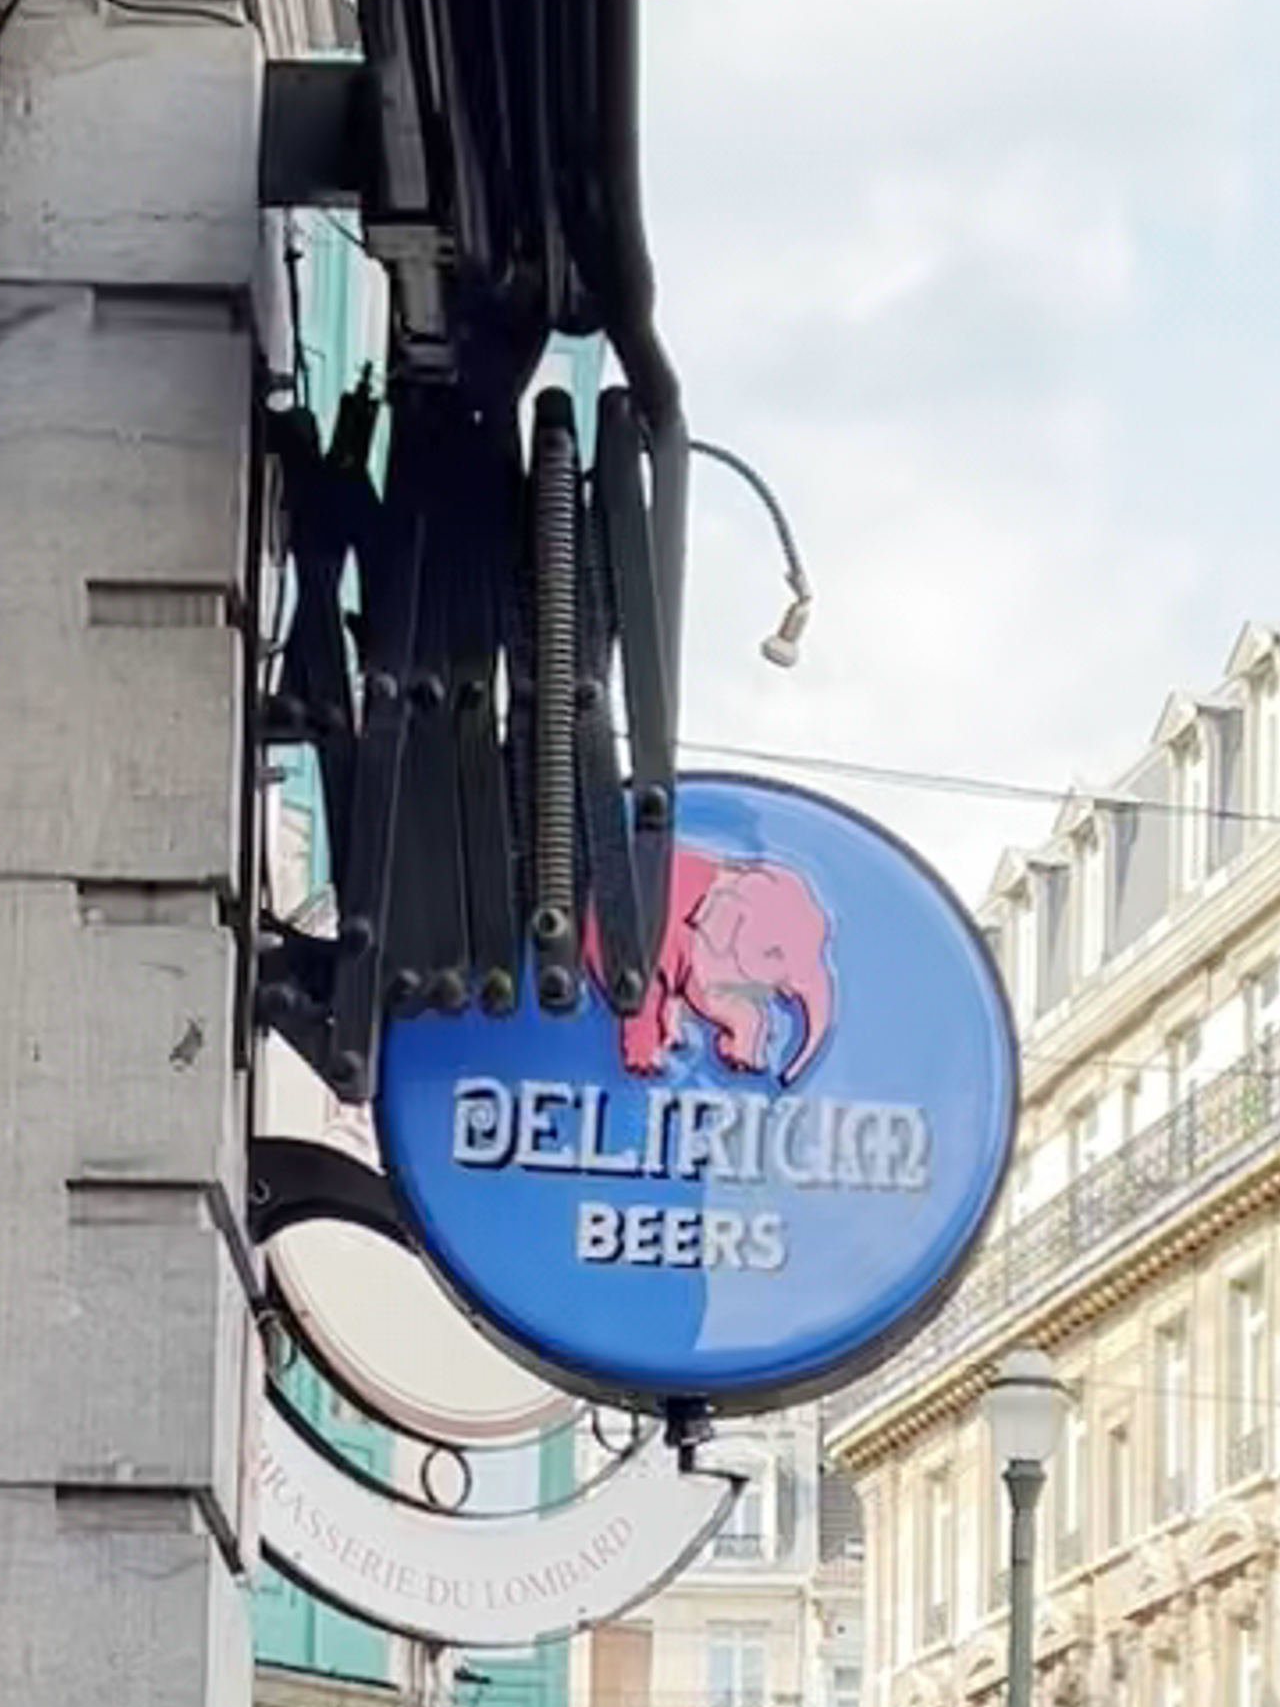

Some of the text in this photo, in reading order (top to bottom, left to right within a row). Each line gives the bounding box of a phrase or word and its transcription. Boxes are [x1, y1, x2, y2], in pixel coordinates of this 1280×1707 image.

[453, 1076, 934, 1191] DELIRIUM
[577, 1200, 788, 1269] BEERS
[425, 1575, 475, 1609] DU
[484, 1515, 634, 1610] LOMBARD
